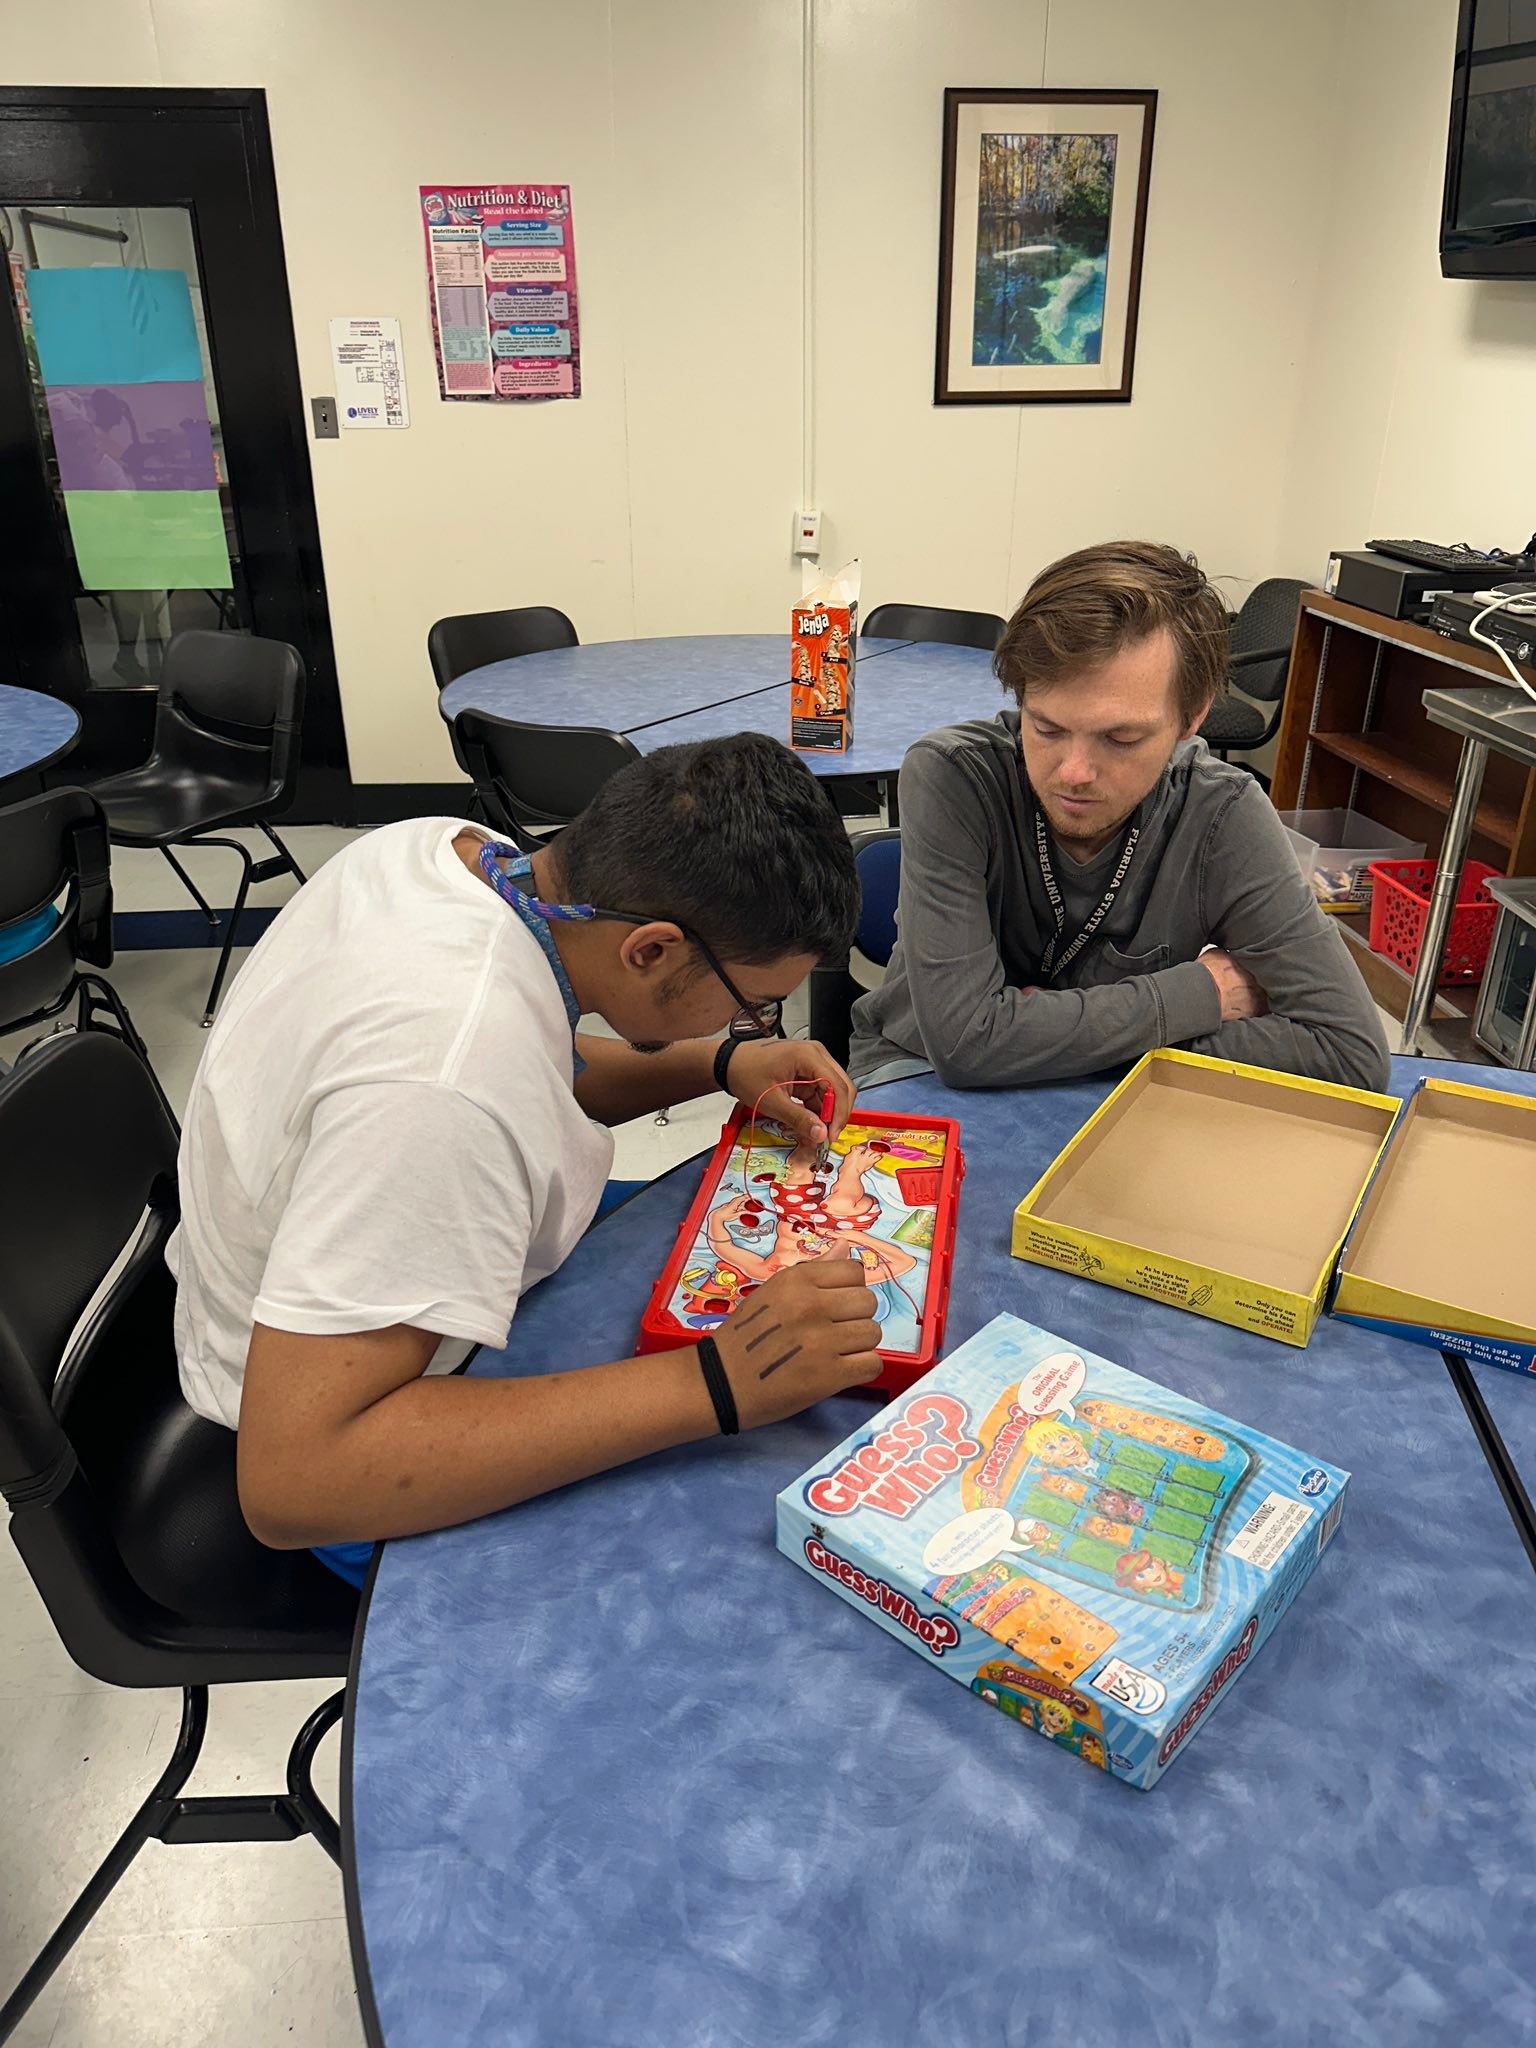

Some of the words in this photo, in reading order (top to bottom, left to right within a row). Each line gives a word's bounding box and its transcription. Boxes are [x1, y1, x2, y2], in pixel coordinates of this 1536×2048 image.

[447, 189, 514, 208] Nutrition
[518, 190, 528, 205] &
[531, 190, 561, 208] Diet
[483, 207, 504, 215] Read
[506, 207, 520, 215] the
[521, 206, 544, 215] Label
[798, 613, 830, 635] Jenga
[1110, 827, 1140, 889] FLORIDA
[1084, 892, 1115, 933] STATE
[1028, 1237, 1056, 1249] something
[1030, 1231, 1046, 1240] When
[1055, 1238, 1079, 1250] swallows
[1041, 1246, 1059, 1256] always
[1060, 1252, 1073, 1260] gets
[1125, 1278, 1137, 1286] he's
[1135, 1269, 1147, 1277] he's
[1148, 1274, 1164, 1282] quite
[1161, 1271, 1174, 1279] lays
[1175, 1274, 1190, 1284] here
[1151, 1280, 1162, 1288] top
[1234, 1300, 1268, 1314] determine
[1256, 1300, 1271, 1309] Only
[1271, 1305, 1284, 1313] you
[1284, 1309, 1296, 1317] can
[1261, 1320, 1293, 1334] OPERATE!
[1274, 1319, 1294, 1329] ahead
[1430, 1330, 1472, 1348] BUZZER!
[1442, 1341, 1472, 1354] better
[1474, 1343, 1490, 1352] the
[1492, 1347, 1509, 1356] get
[1474, 1350, 1492, 1360] him
[1494, 1355, 1520, 1368] Make
[1032, 1367, 1061, 1397] ORIGINAL
[1033, 1380, 1068, 1413] Guessing
[1060, 1360, 1081, 1382] Game
[1244, 1502, 1276, 1535] WARNING:
[1152, 1643, 1179, 1673] AGES
[1174, 1631, 1190, 1644] 5+
[1168, 1641, 1196, 1672] PLAYERS
[1101, 1671, 1119, 1691] made
[1108, 1669, 1147, 1702] USA
